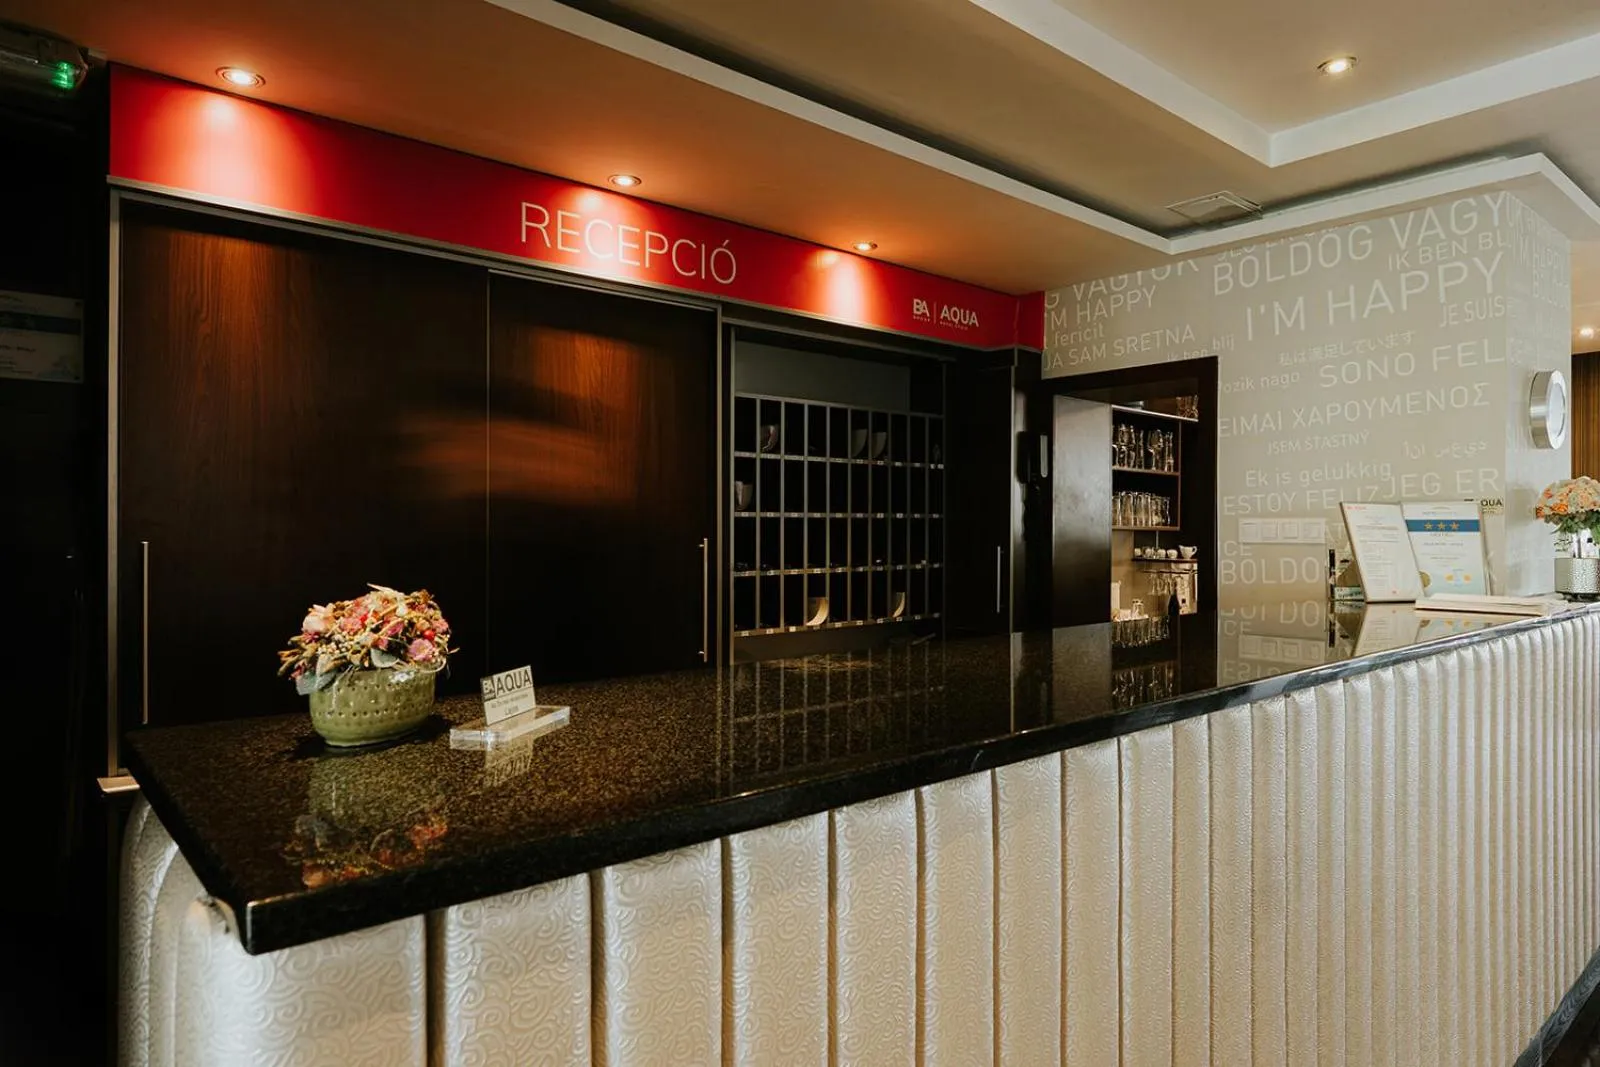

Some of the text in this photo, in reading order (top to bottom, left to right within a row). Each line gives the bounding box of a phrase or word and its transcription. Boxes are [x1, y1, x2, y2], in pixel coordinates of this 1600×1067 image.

[521, 201, 737, 284] RECEPCIÓ
[1388, 252, 1411, 271] IK
[1418, 236, 1468, 265] BEN
[1213, 224, 1373, 296] BOLDOG
[1076, 284, 1156, 325] HAPPY
[1246, 296, 1305, 341] I'M
[1327, 251, 1504, 326] HAPPY
[940, 304, 980, 328] AQUA
[1054, 322, 1104, 348] fericit
[1068, 342, 1107, 366] SAM
[1113, 324, 1196, 357] SRETNA
[1219, 376, 1256, 394] ozik
[1320, 352, 1416, 388] SONO
[1245, 460, 1391, 487] Ek is gelukkig
[1382, 468, 1500, 499] JEG ER
[1222, 491, 1297, 516] ESTOY
[1480, 498, 1504, 507] QUA
[1220, 556, 1321, 585] BOLDO
[496, 668, 533, 696] AQUA
